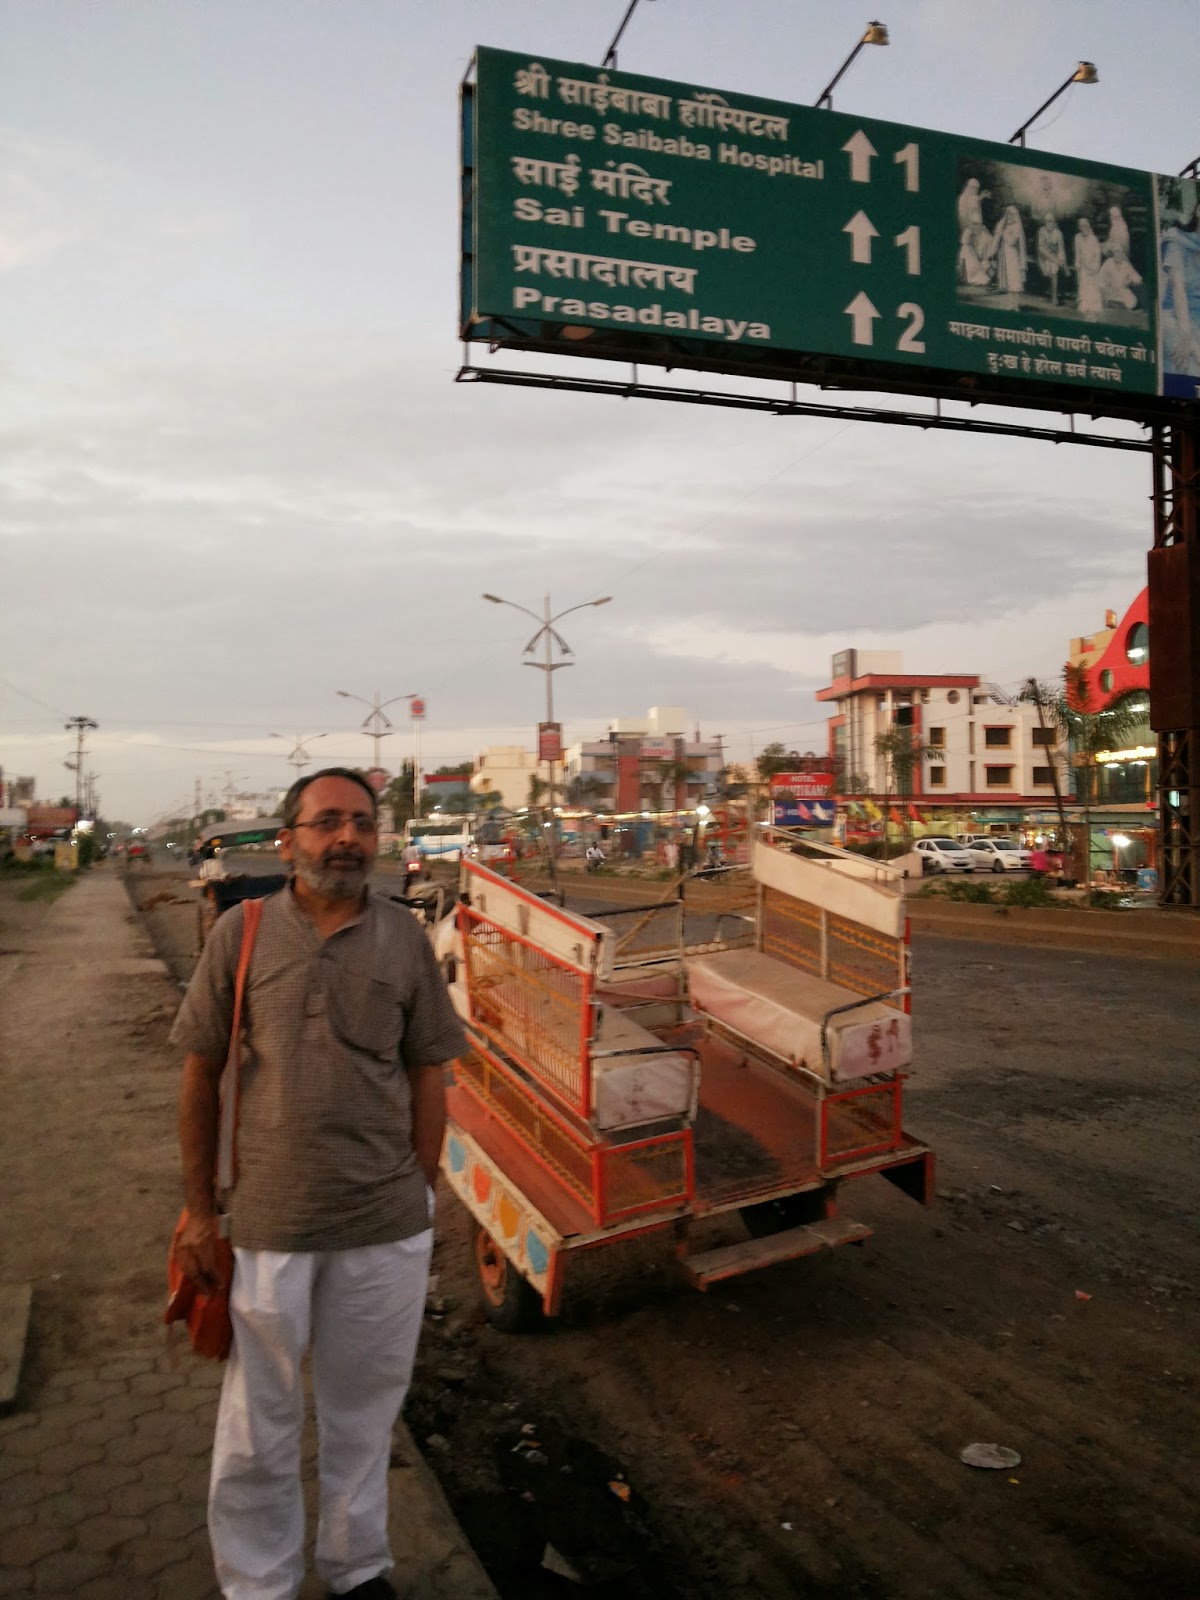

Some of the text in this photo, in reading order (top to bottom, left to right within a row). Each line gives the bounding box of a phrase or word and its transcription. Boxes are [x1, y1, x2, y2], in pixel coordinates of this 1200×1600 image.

[514, 63, 551, 99] श्री
[556, 74, 672, 120] साईबाबा
[512, 108, 824, 180] Shree Saibaba Hospital
[893, 142, 920, 192] 1
[511, 153, 672, 205] साई मंदिर
[513, 198, 757, 252] Sai Temple
[894, 225, 921, 276] 1
[511, 244, 698, 295] प्रसादालय
[512, 286, 771, 341] Prasadalaya
[896, 302, 926, 354] 2
